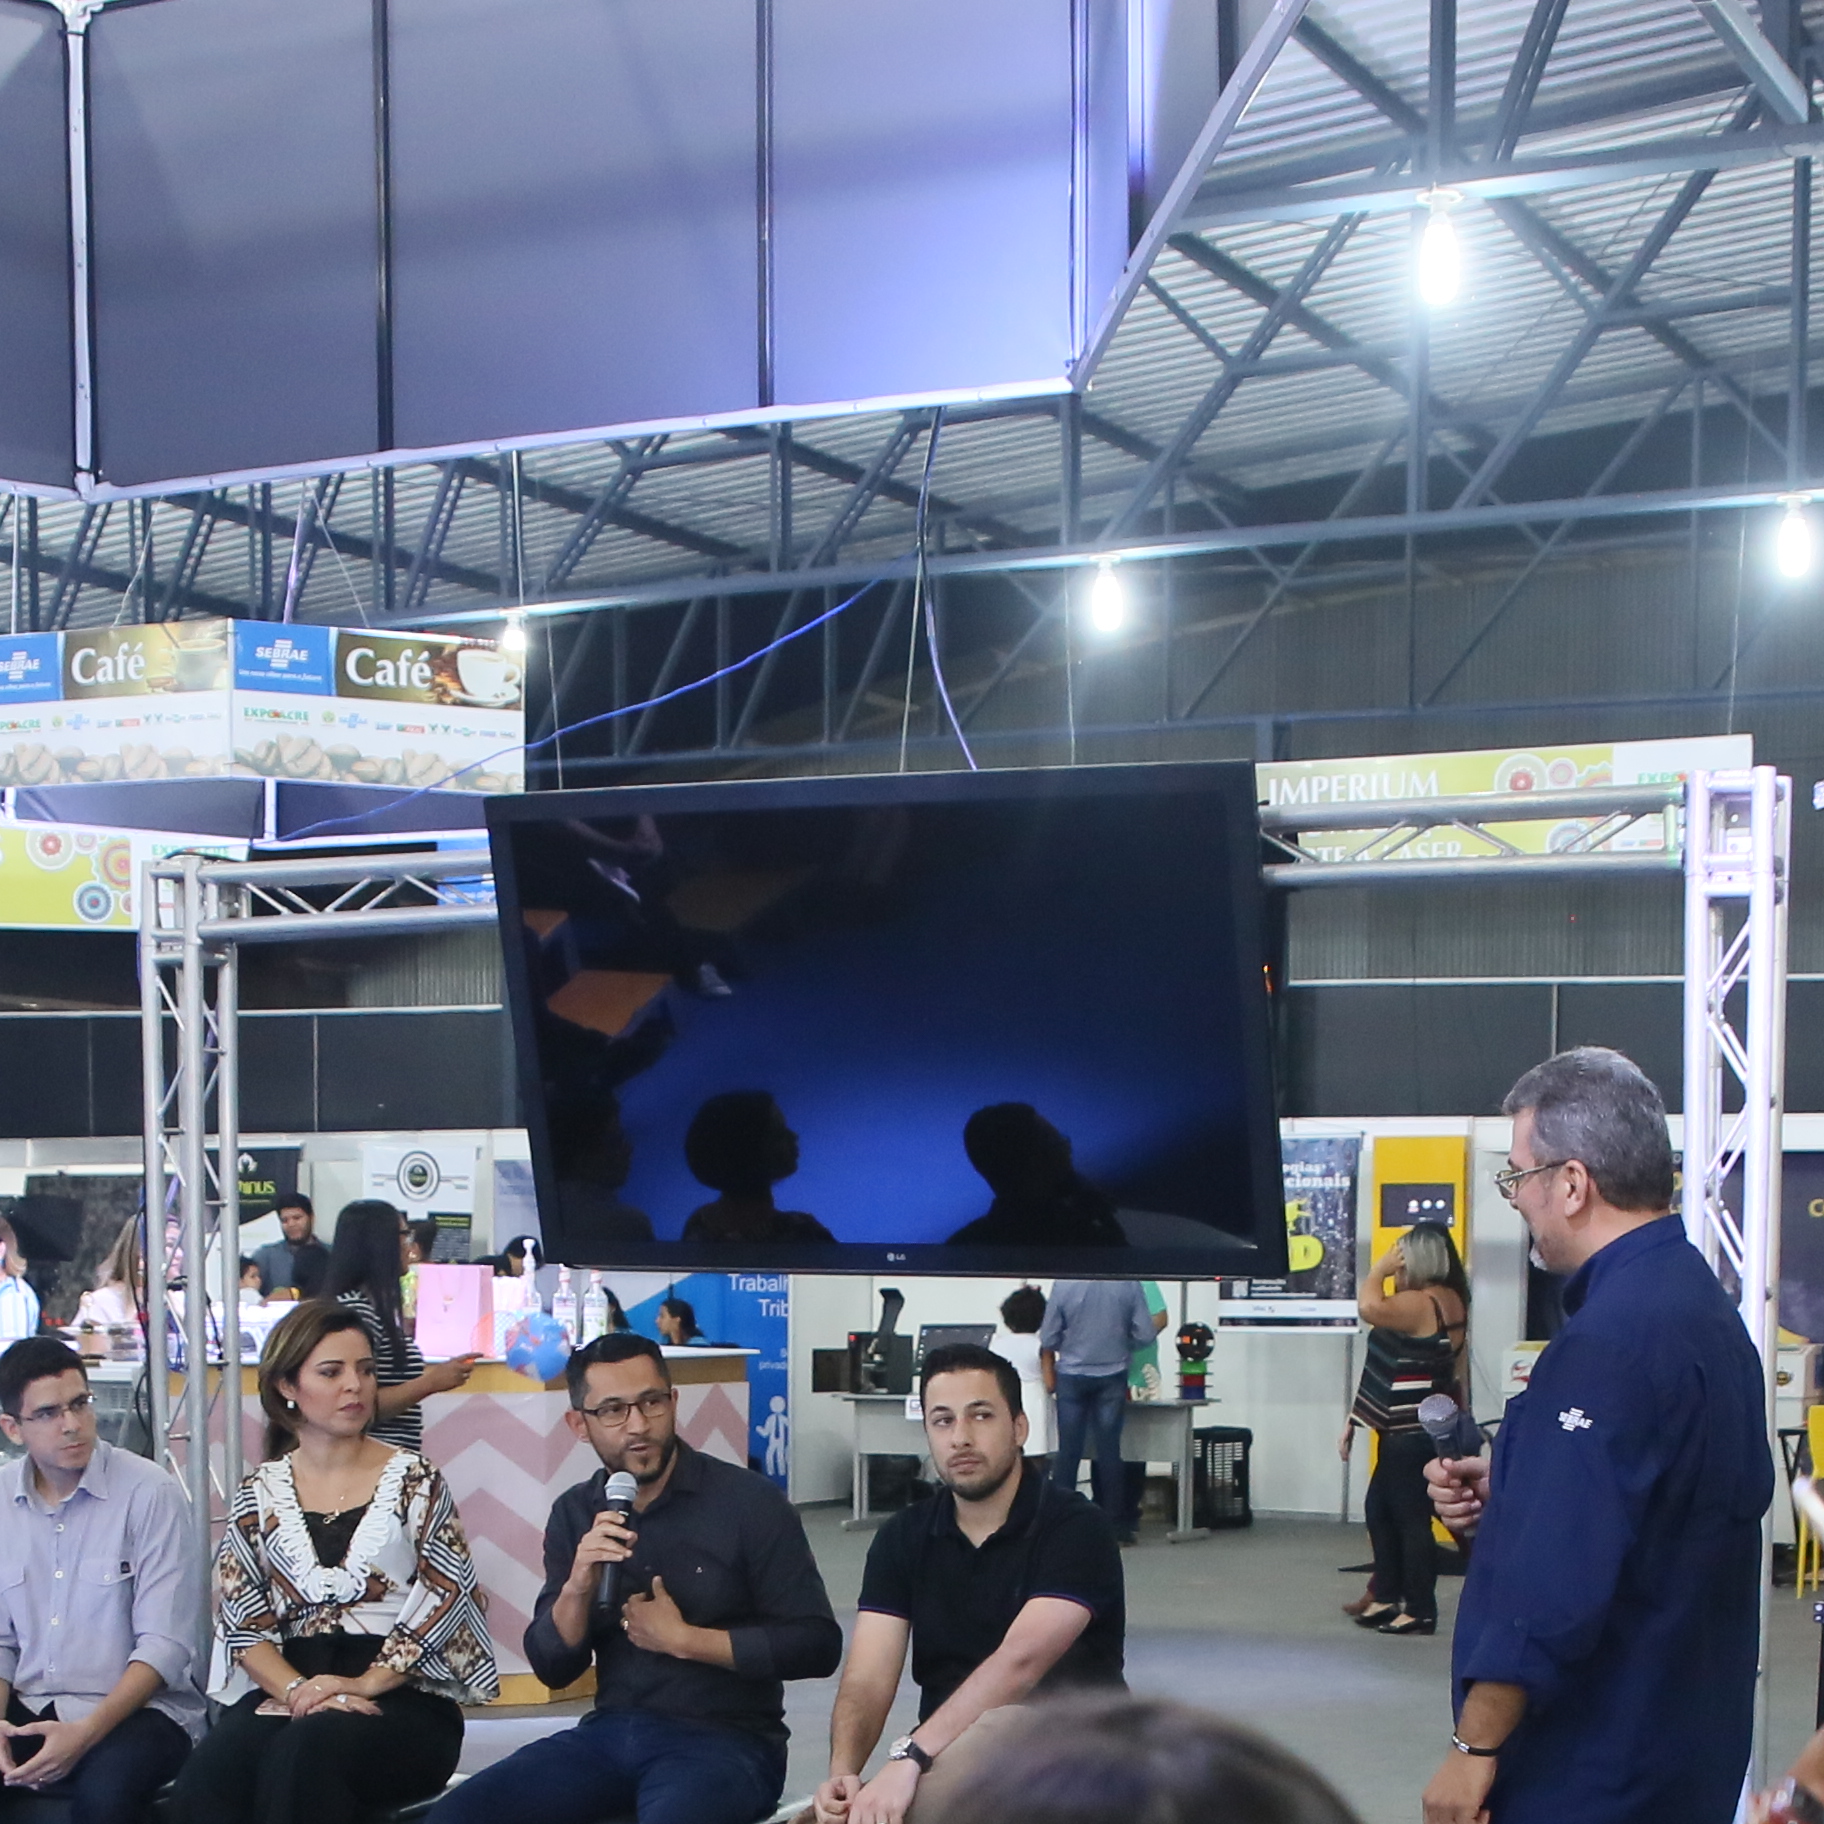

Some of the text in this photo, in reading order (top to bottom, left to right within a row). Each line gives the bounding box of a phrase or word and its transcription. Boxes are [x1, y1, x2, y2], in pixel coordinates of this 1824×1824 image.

[71, 642, 147, 686] Café
[255, 646, 309, 661] SEBRAE
[344, 647, 433, 690] Café
[1268, 769, 1439, 806] IMPERIUM
